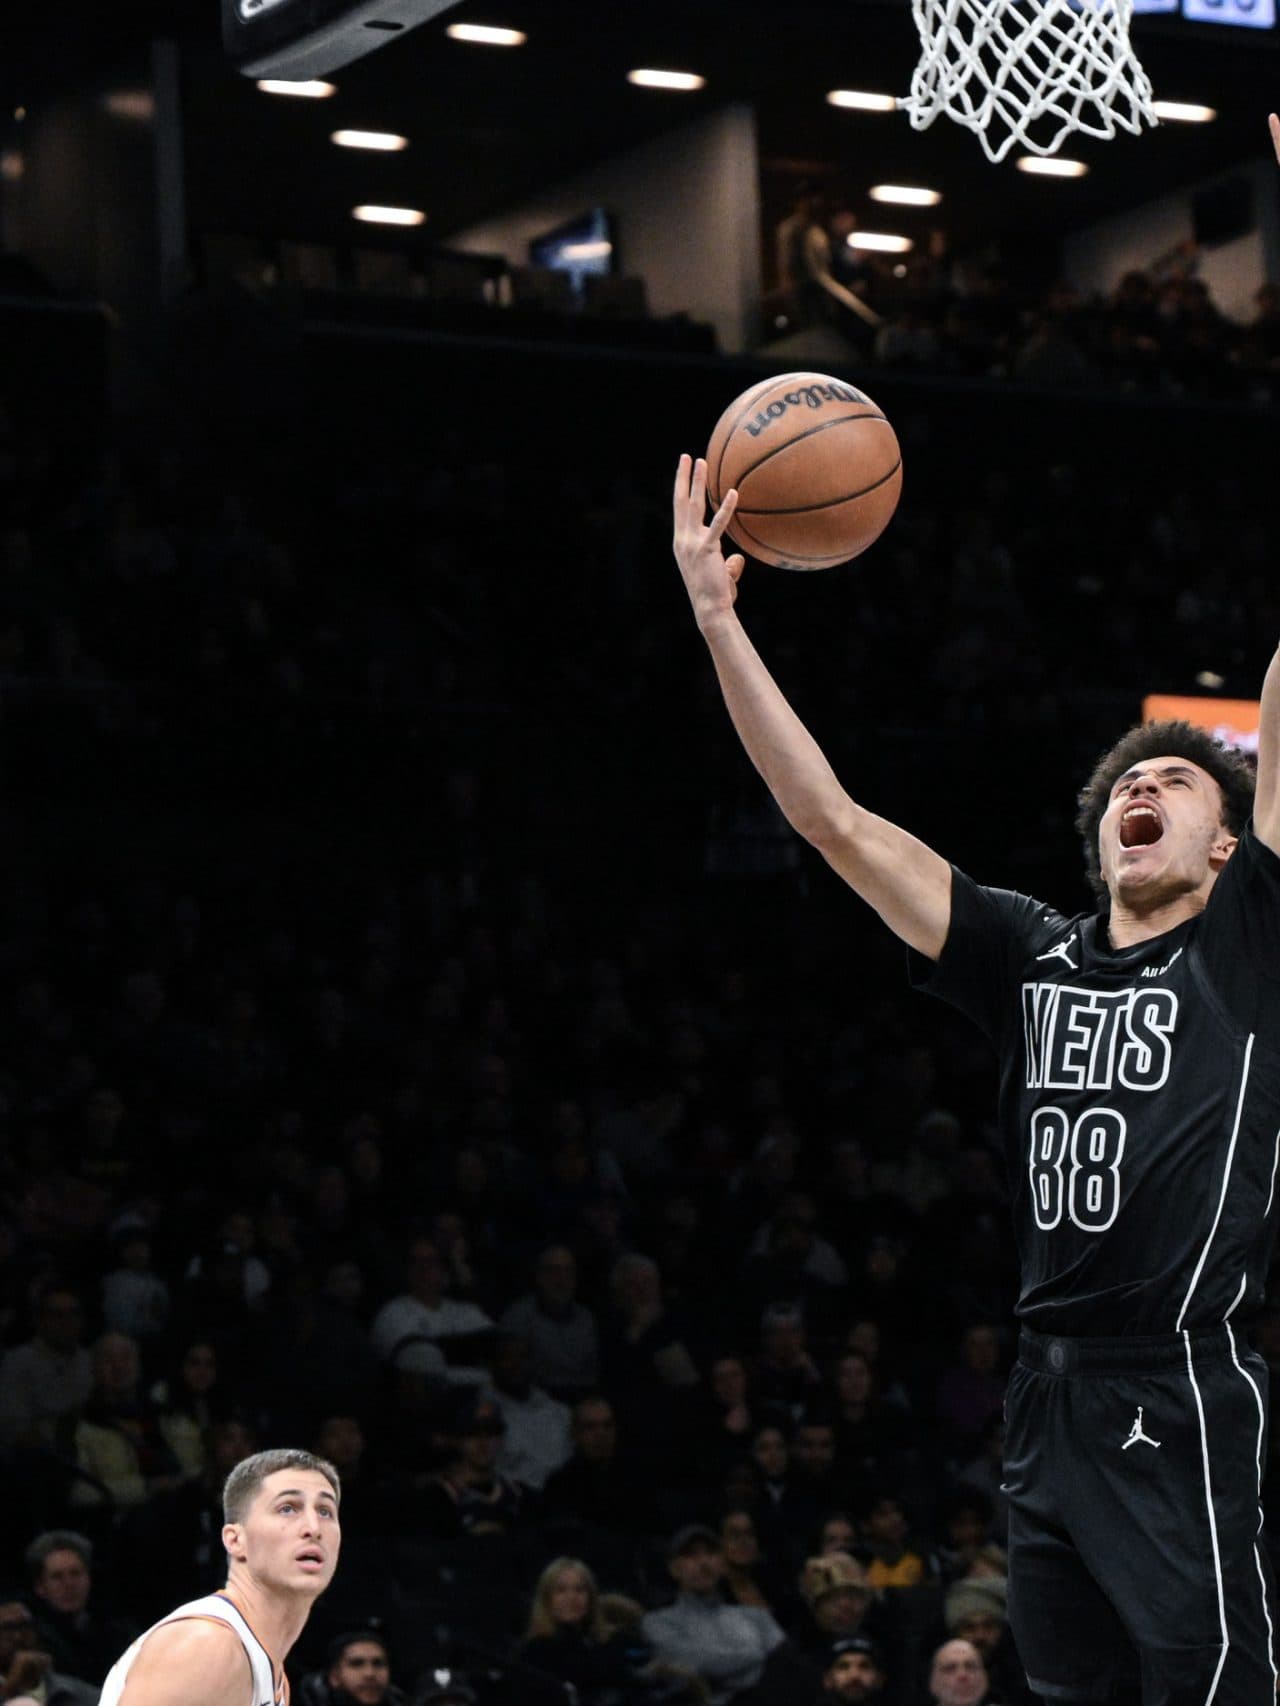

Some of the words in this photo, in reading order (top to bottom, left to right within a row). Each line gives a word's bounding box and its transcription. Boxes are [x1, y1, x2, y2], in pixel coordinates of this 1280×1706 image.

[744, 382, 868, 437] Wilson
[1022, 983, 1178, 1091] NETS
[1029, 1106, 1127, 1232] 88
